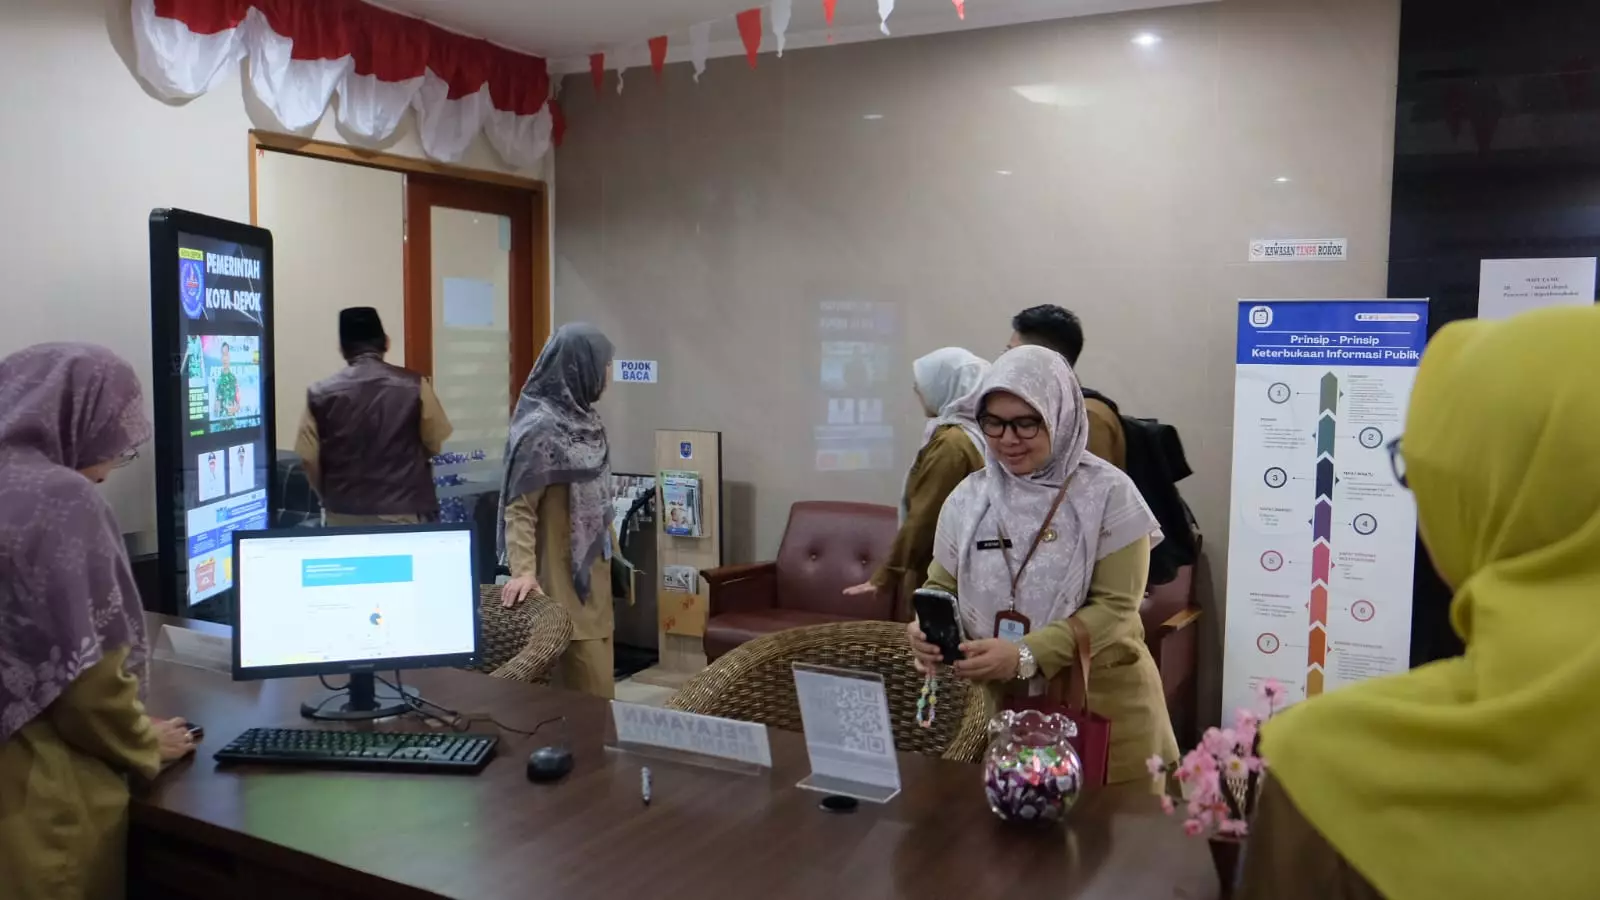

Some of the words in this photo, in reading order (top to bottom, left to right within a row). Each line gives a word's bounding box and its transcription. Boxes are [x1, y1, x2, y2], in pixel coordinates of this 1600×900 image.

[1264, 245, 1295, 256] KAWASAN
[1318, 245, 1343, 256] ROKOK
[206, 252, 260, 279] PEMERINTAH
[205, 287, 231, 310] KOTA
[233, 290, 261, 312] DEPOK
[1290, 334, 1330, 346] Prinsip
[1339, 335, 1380, 347] Prinsip
[1251, 348, 1325, 359] Keterbukaan
[1326, 349, 1382, 360] Informasi
[1384, 350, 1420, 361] Publik
[621, 361, 651, 371] POJOK
[622, 371, 650, 381] BACA
